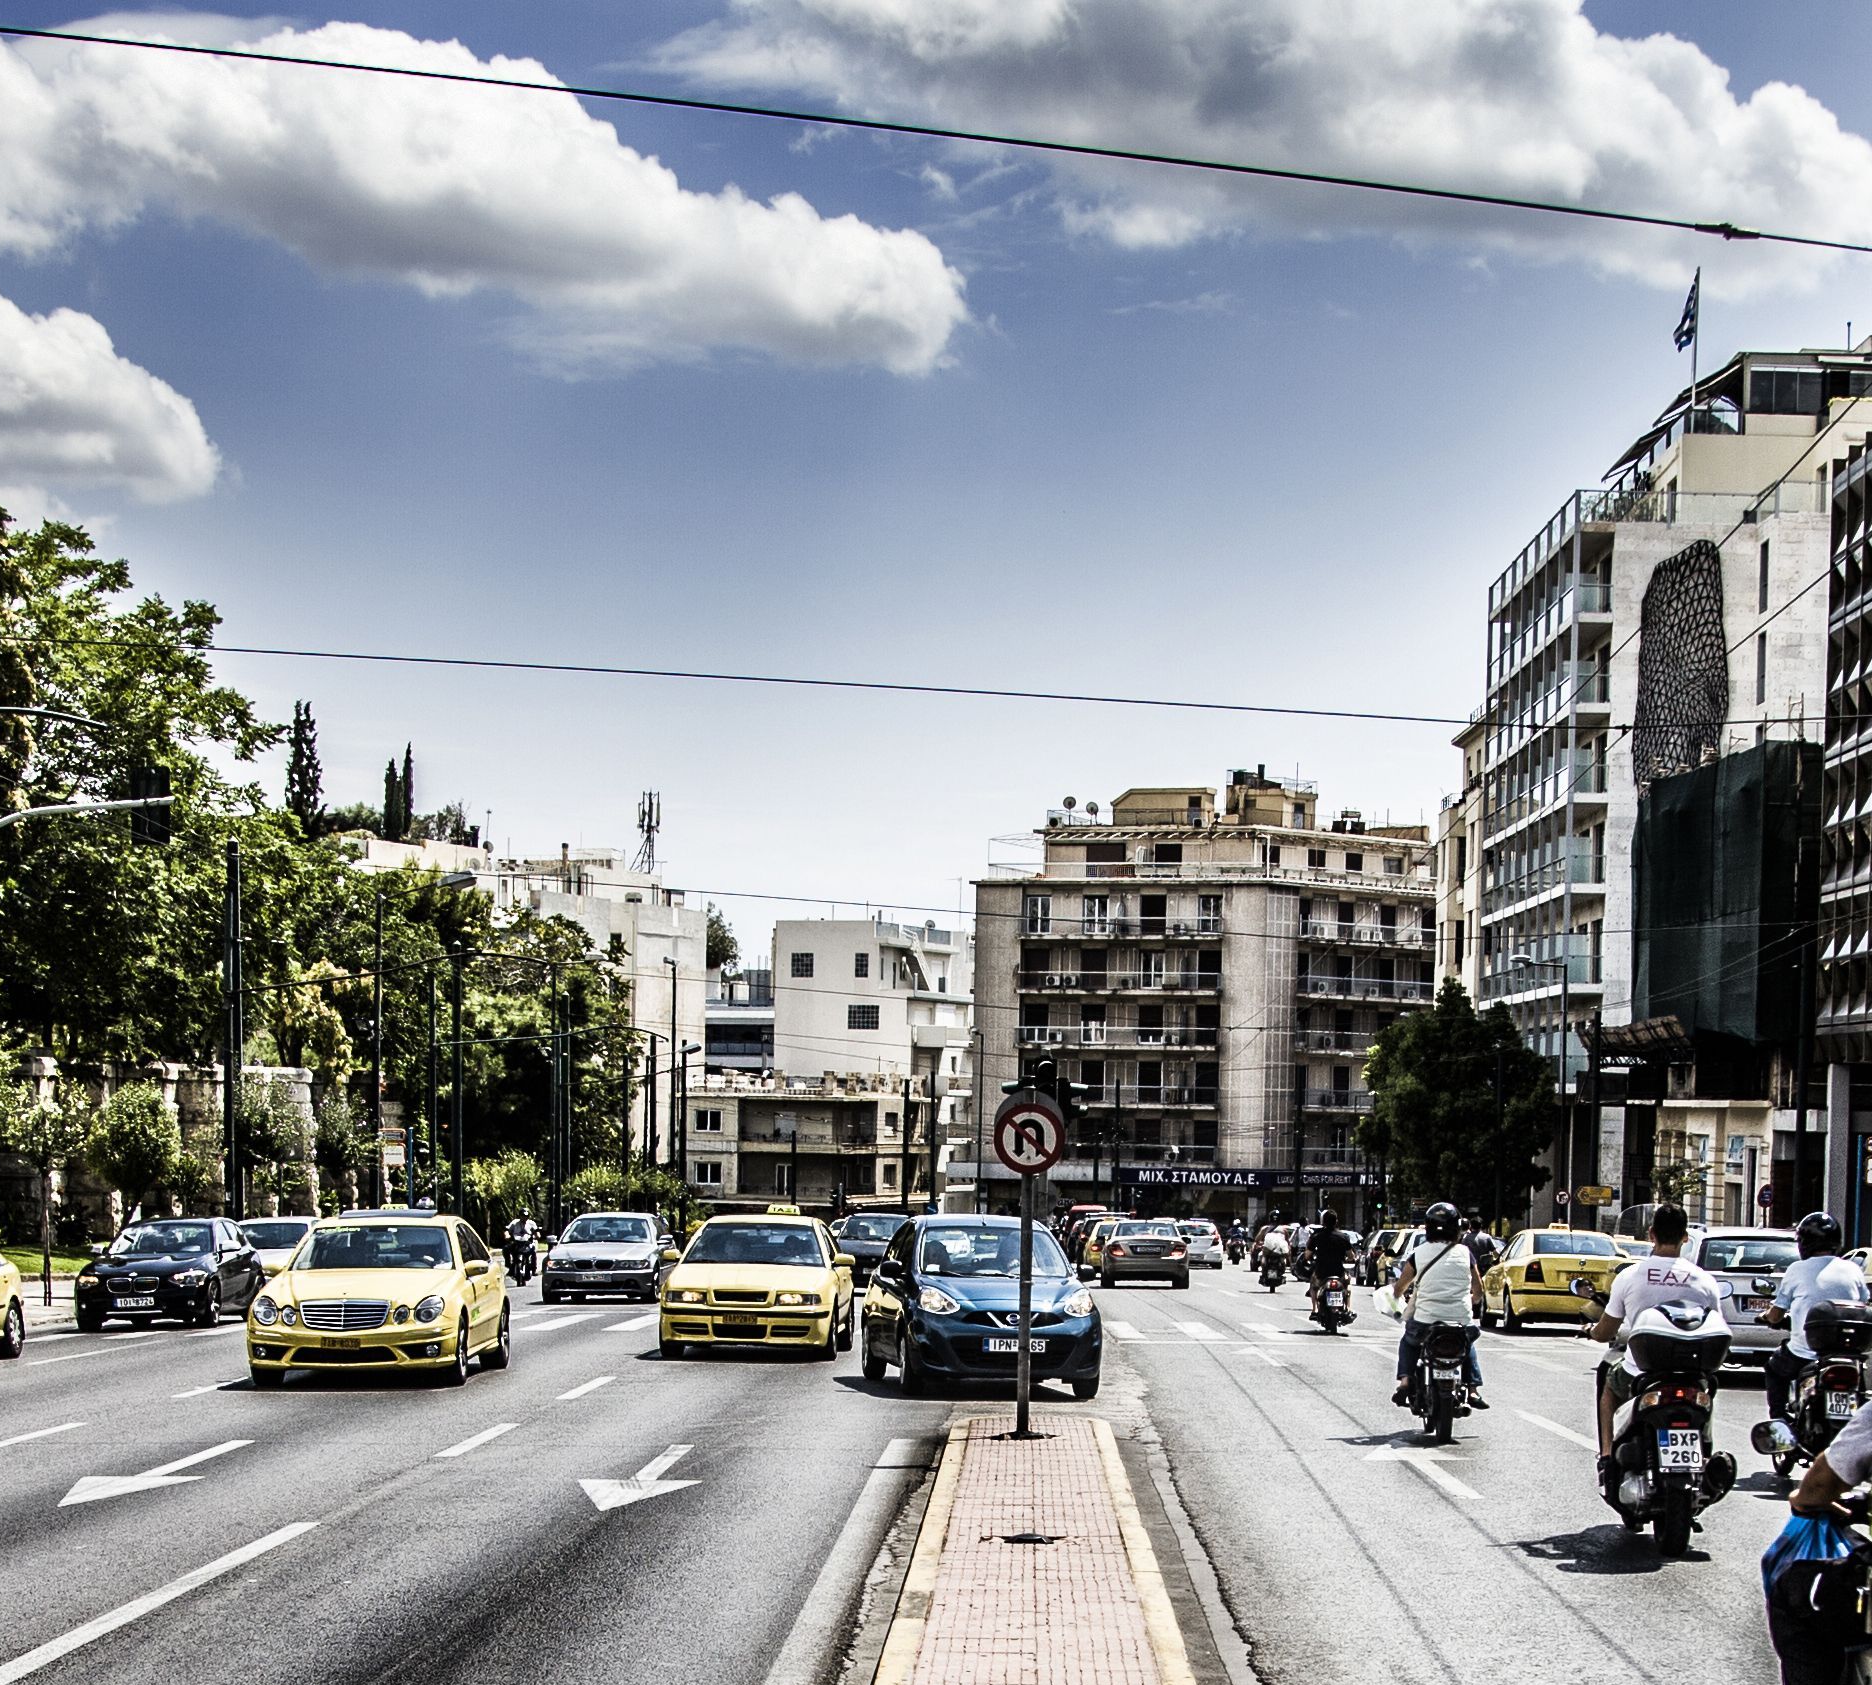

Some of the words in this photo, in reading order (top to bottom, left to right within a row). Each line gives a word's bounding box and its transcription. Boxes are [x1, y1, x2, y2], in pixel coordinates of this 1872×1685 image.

[1171, 1171, 1231, 1184] ΣΤΑΜΟΥ
[1828, 1402, 1848, 1414] 407
[1671, 1450, 1701, 1464] 260
